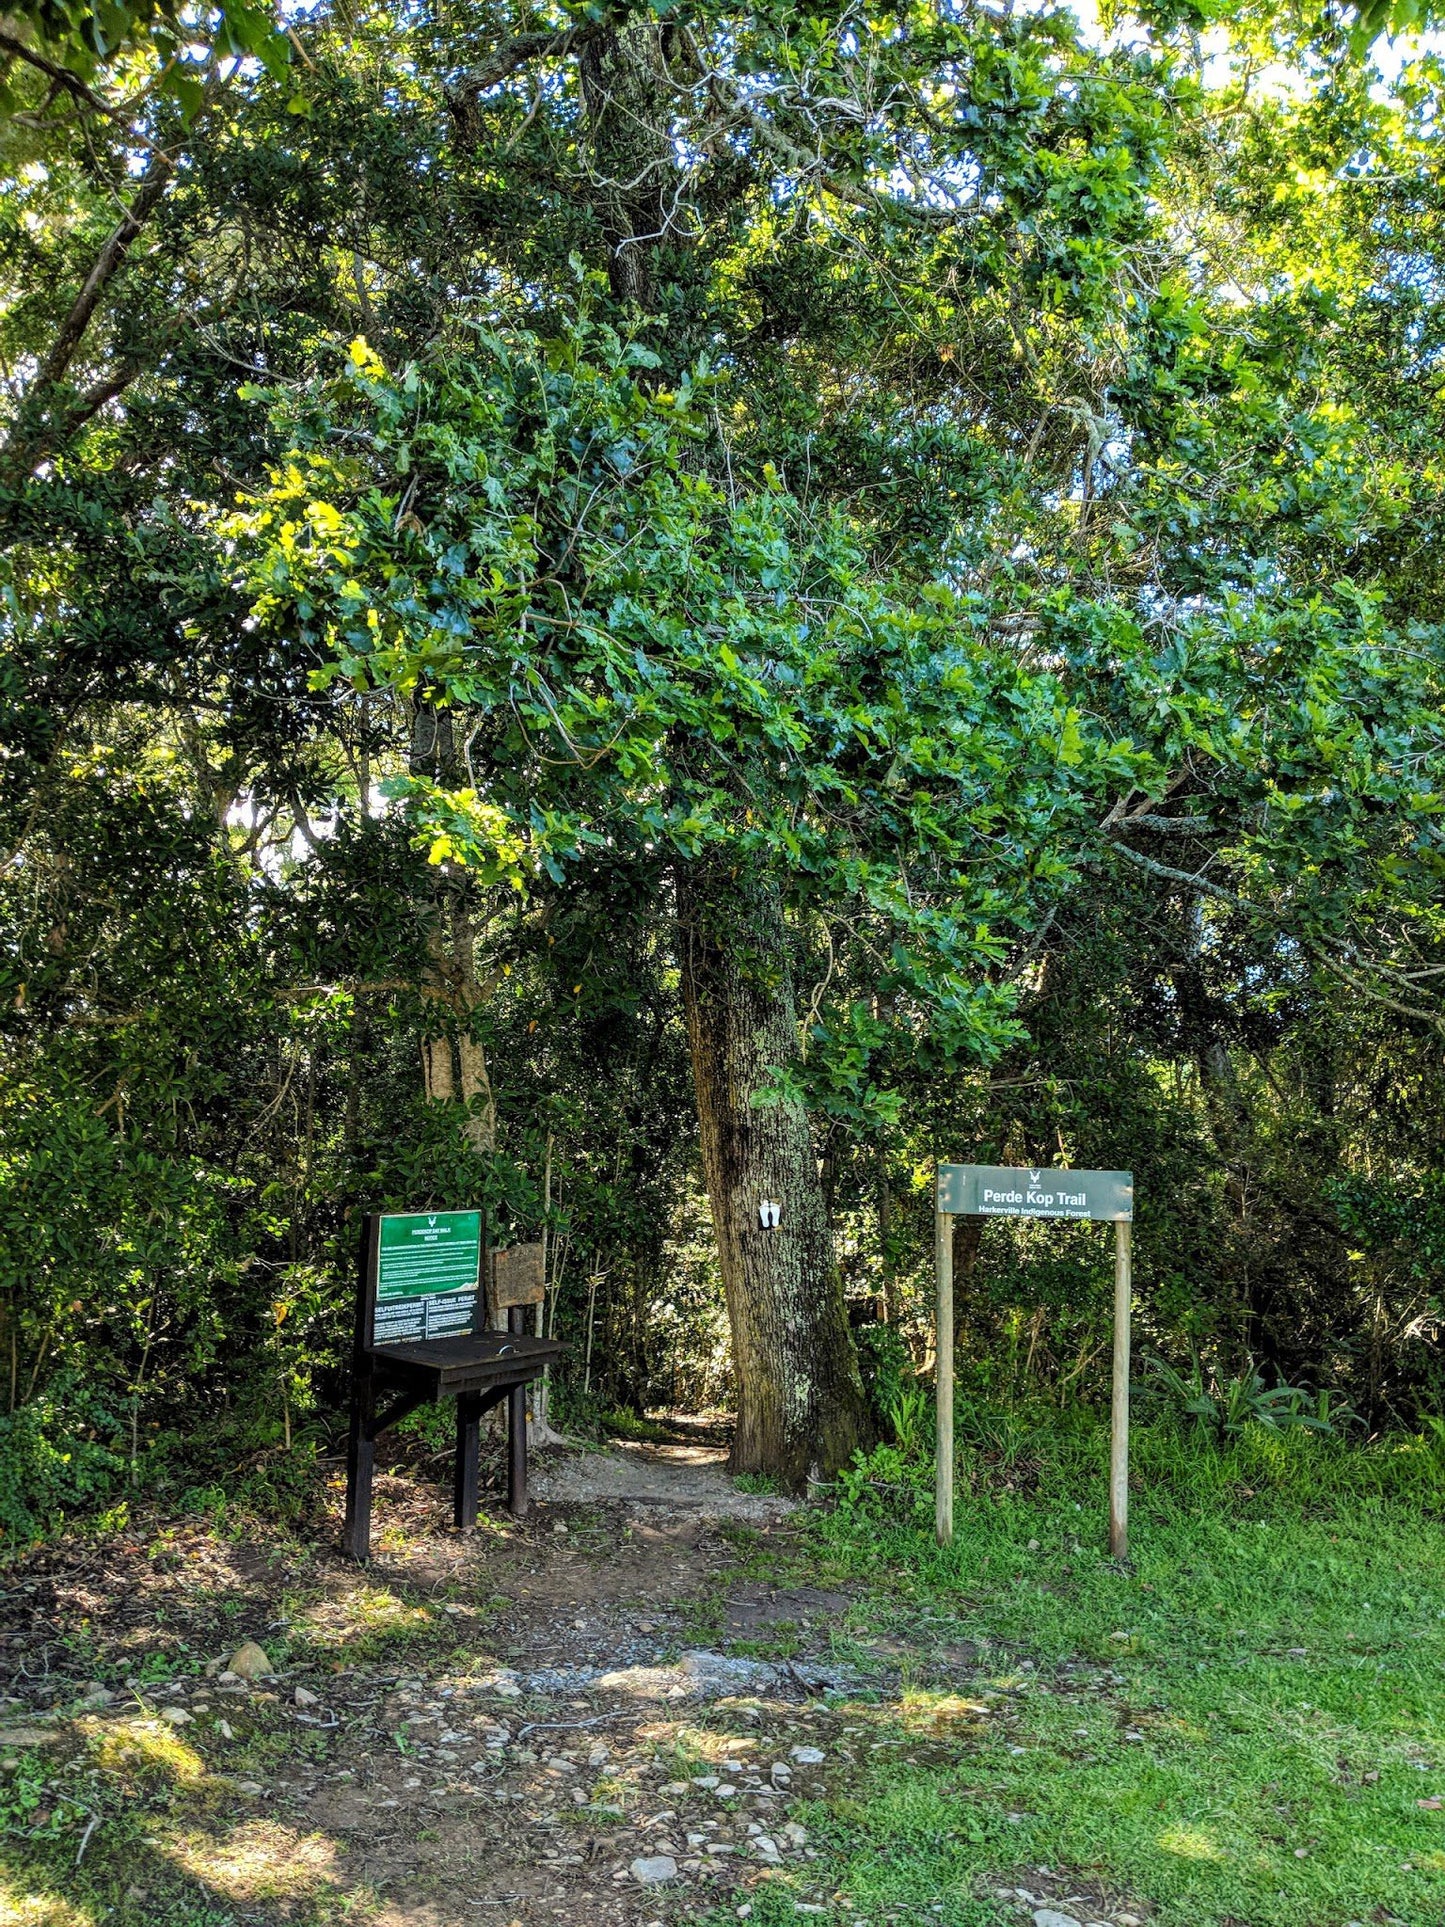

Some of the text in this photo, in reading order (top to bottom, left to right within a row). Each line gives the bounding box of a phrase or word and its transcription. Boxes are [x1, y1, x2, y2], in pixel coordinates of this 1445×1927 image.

[984, 1189, 1086, 1207] Perde Kop Trail
[979, 1205, 1091, 1218] Harkerville Indigenous Forest
